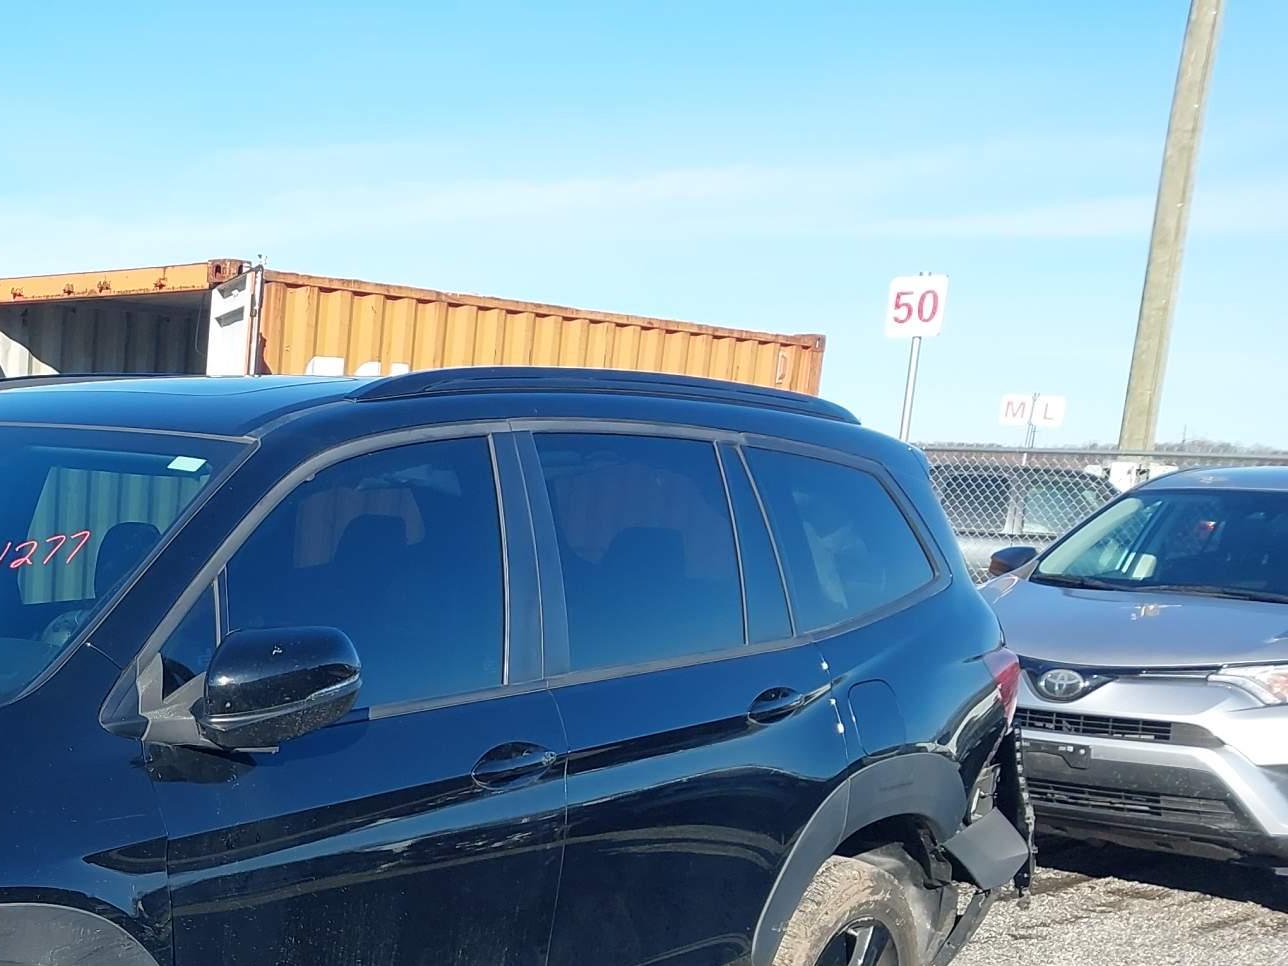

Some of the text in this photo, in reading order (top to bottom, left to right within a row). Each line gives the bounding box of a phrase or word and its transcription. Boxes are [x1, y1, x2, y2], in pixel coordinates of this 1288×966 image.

[893, 290, 939, 324] 50
[1005, 401, 1025, 418] M
[1043, 403, 1054, 420] L
